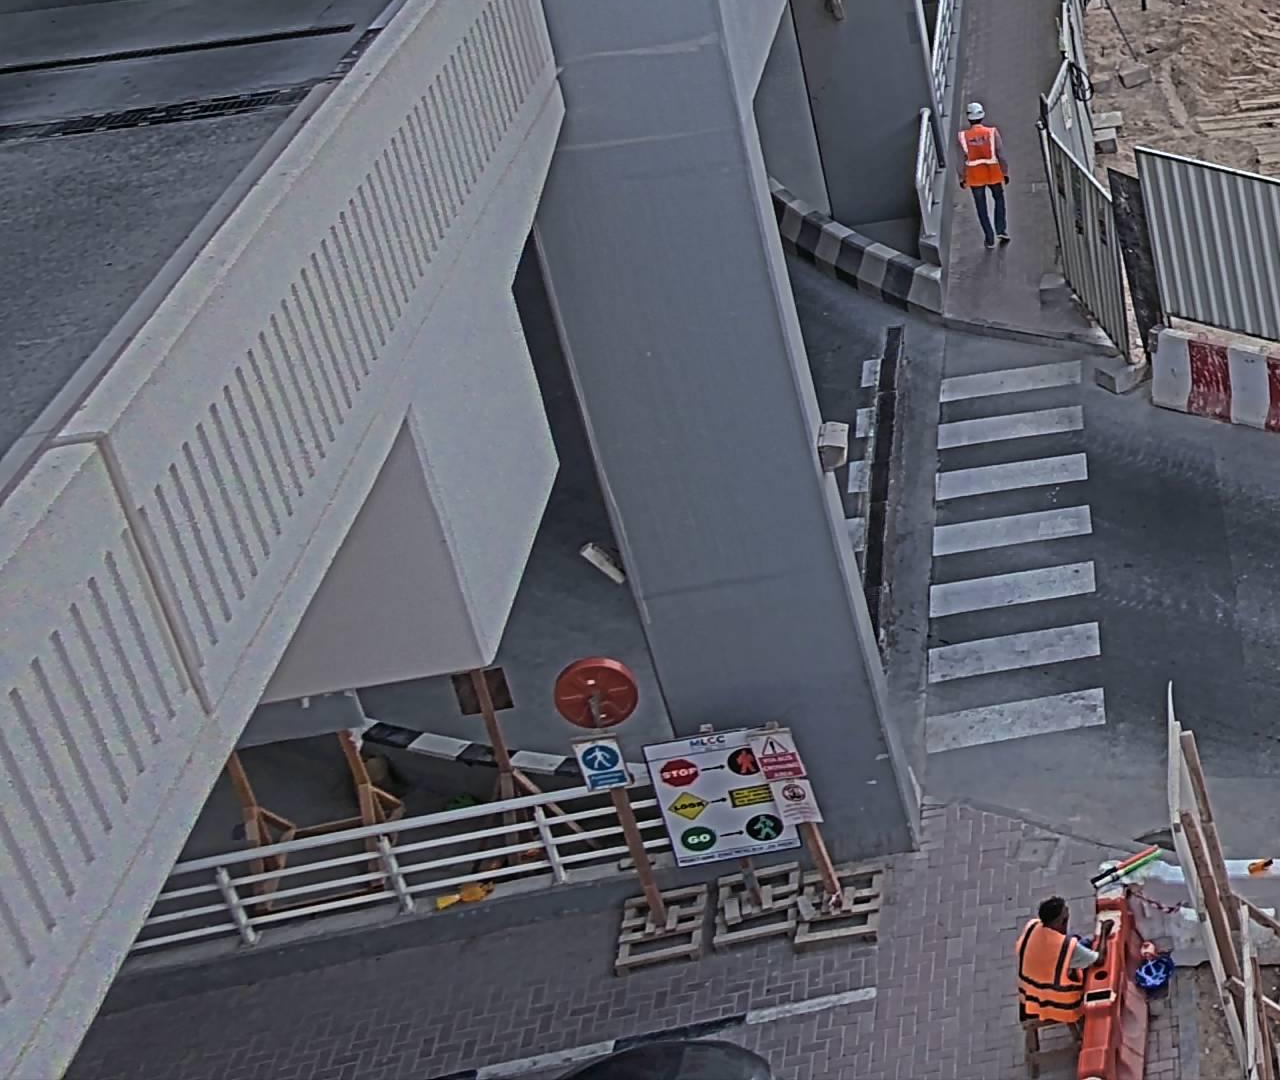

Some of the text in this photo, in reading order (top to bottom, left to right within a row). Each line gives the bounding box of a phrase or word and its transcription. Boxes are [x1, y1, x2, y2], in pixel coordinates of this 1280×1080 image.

[689, 735, 726, 747] MLCC
[661, 766, 698, 780] STOP
[674, 801, 704, 812] LOOK
[687, 833, 711, 845] GO
